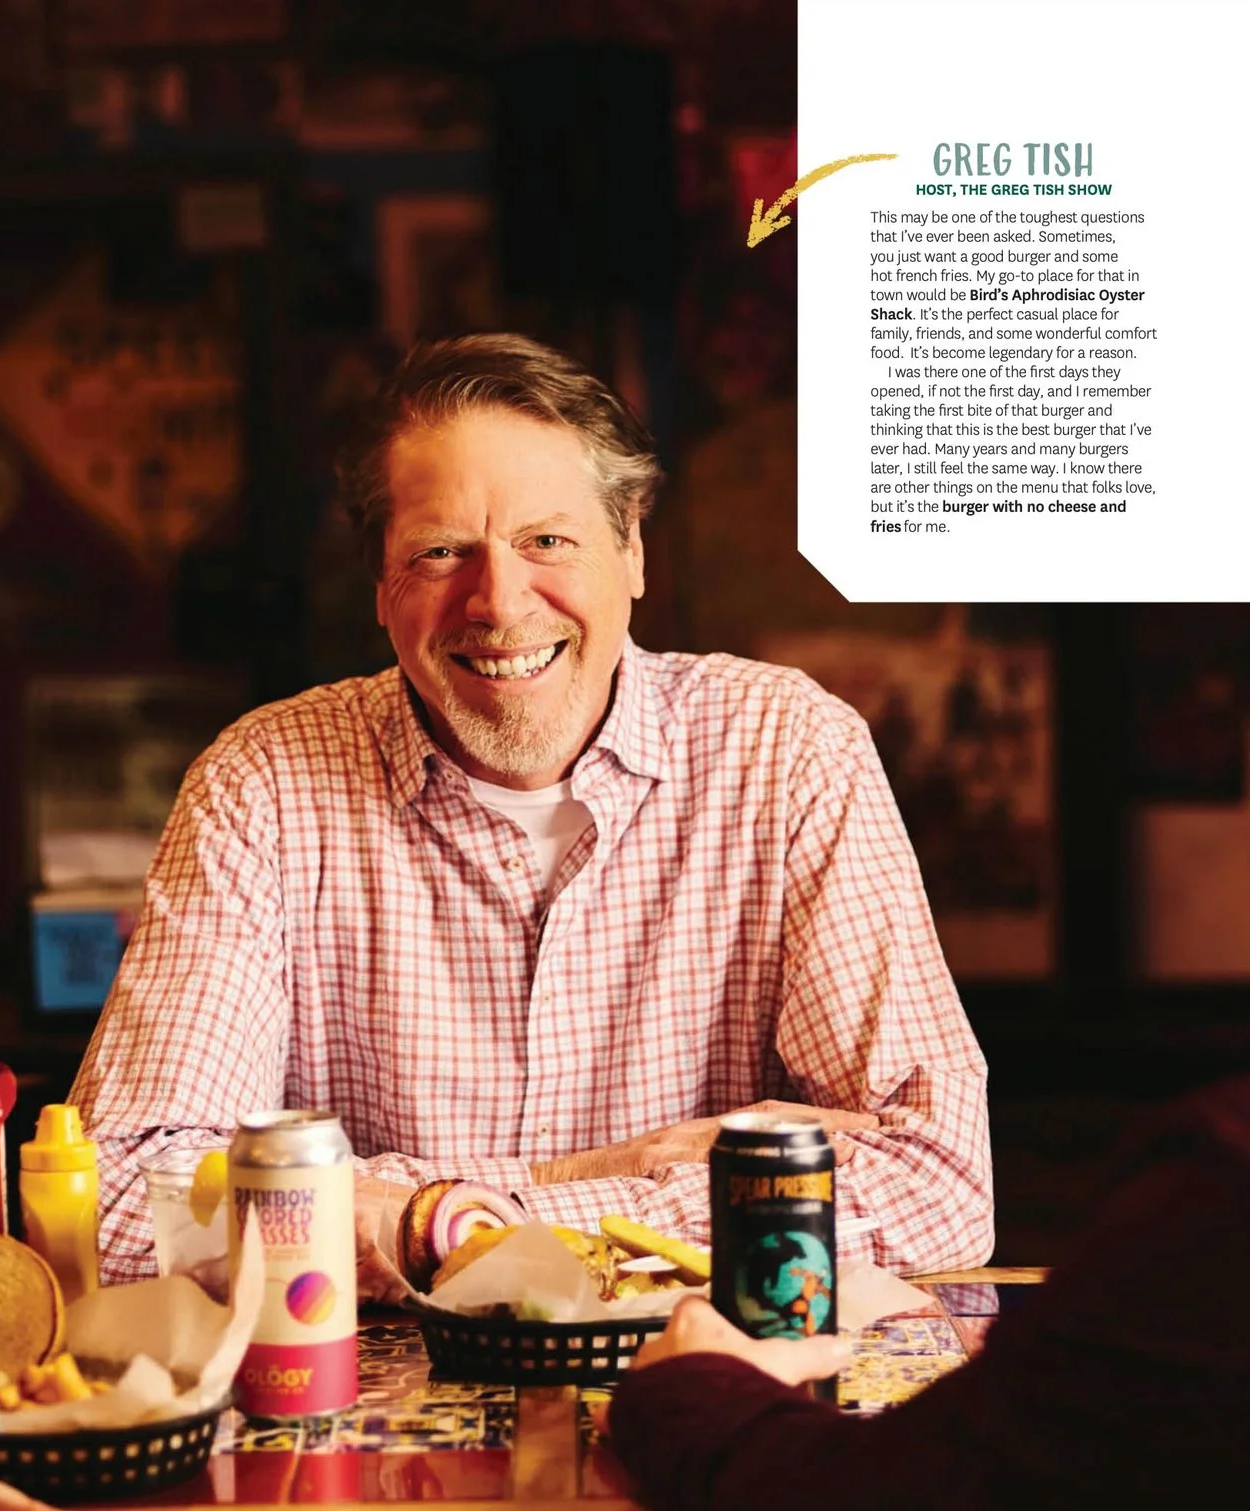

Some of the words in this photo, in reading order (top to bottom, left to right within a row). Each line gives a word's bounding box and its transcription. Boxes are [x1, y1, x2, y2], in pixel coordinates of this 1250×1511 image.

[933, 142, 1012, 177] GREG
[1022, 142, 1093, 178] TISH
[915, 183, 957, 198] HOST,
[959, 183, 988, 196] THE
[990, 183, 1030, 196] GREG
[1032, 183, 1065, 196] TISH
[1067, 183, 1113, 196] SHOW
[870, 210, 898, 224] This
[901, 213, 929, 227] may
[931, 210, 949, 224] be
[951, 213, 976, 224] one
[979, 209, 995, 224] of
[994, 209, 1017, 224] the
[1019, 210, 1078, 227] toughest
[1080, 210, 1145, 227] questions
[870, 229, 898, 243] that
[926, 232, 955, 243] ever
[957, 229, 990, 243] been
[993, 229, 1035, 243] asked.
[1038, 229, 1116, 244] Sometimes,
[870, 268, 893, 282] hot
[895, 268, 938, 282] french
[940, 268, 972, 282] fries.
[976, 269, 996, 286] My
[998, 270, 1035, 286] go-to
[1038, 268, 1074, 286] place
[1076, 268, 1095, 282] for
[1097, 268, 1125, 282] that
[1128, 268, 1140, 282] in
[870, 289, 903, 302] town
[906, 287, 946, 302] would
[950, 287, 967, 302] be
[1011, 287, 1096, 305] Aphrodisiac
[1098, 288, 1146, 305] Oyster
[870, 307, 916, 321] Shack.
[941, 307, 963, 321] the
[966, 306, 1014, 324] perfect
[1016, 307, 1059, 321] casual
[1062, 307, 1098, 324] place
[1100, 306, 1120, 321] for
[870, 345, 904, 359] food.
[932, 345, 986, 359] become
[989, 345, 1054, 363] legendary
[1056, 345, 1075, 359] for
[1077, 348, 1086, 359] a
[1089, 348, 1137, 359] reason.
[870, 403, 911, 421] taking
[913, 403, 936, 417] the
[938, 403, 964, 417] first
[967, 403, 993, 417] bite
[995, 403, 1010, 417] of
[1011, 403, 1038, 417] that
[1041, 403, 1085, 421] burger
[1087, 403, 1113, 417] and
[870, 445, 900, 455] ever
[902, 441, 931, 455] had.
[935, 443, 971, 459] Many
[972, 445, 1008, 459] years
[1010, 441, 1036, 455] and
[1039, 445, 1076, 459] many
[1079, 441, 1129, 459] burgers
[871, 499, 894, 513] but
[917, 499, 939, 513] the
[942, 499, 990, 517] burger
[992, 499, 1023, 513] with
[1027, 502, 1045, 513] no
[1047, 499, 1097, 513] cheese
[1099, 499, 1127, 513] and
[869, 519, 902, 533] fries
[903, 519, 923, 533] for
[925, 522, 950, 533] me.
